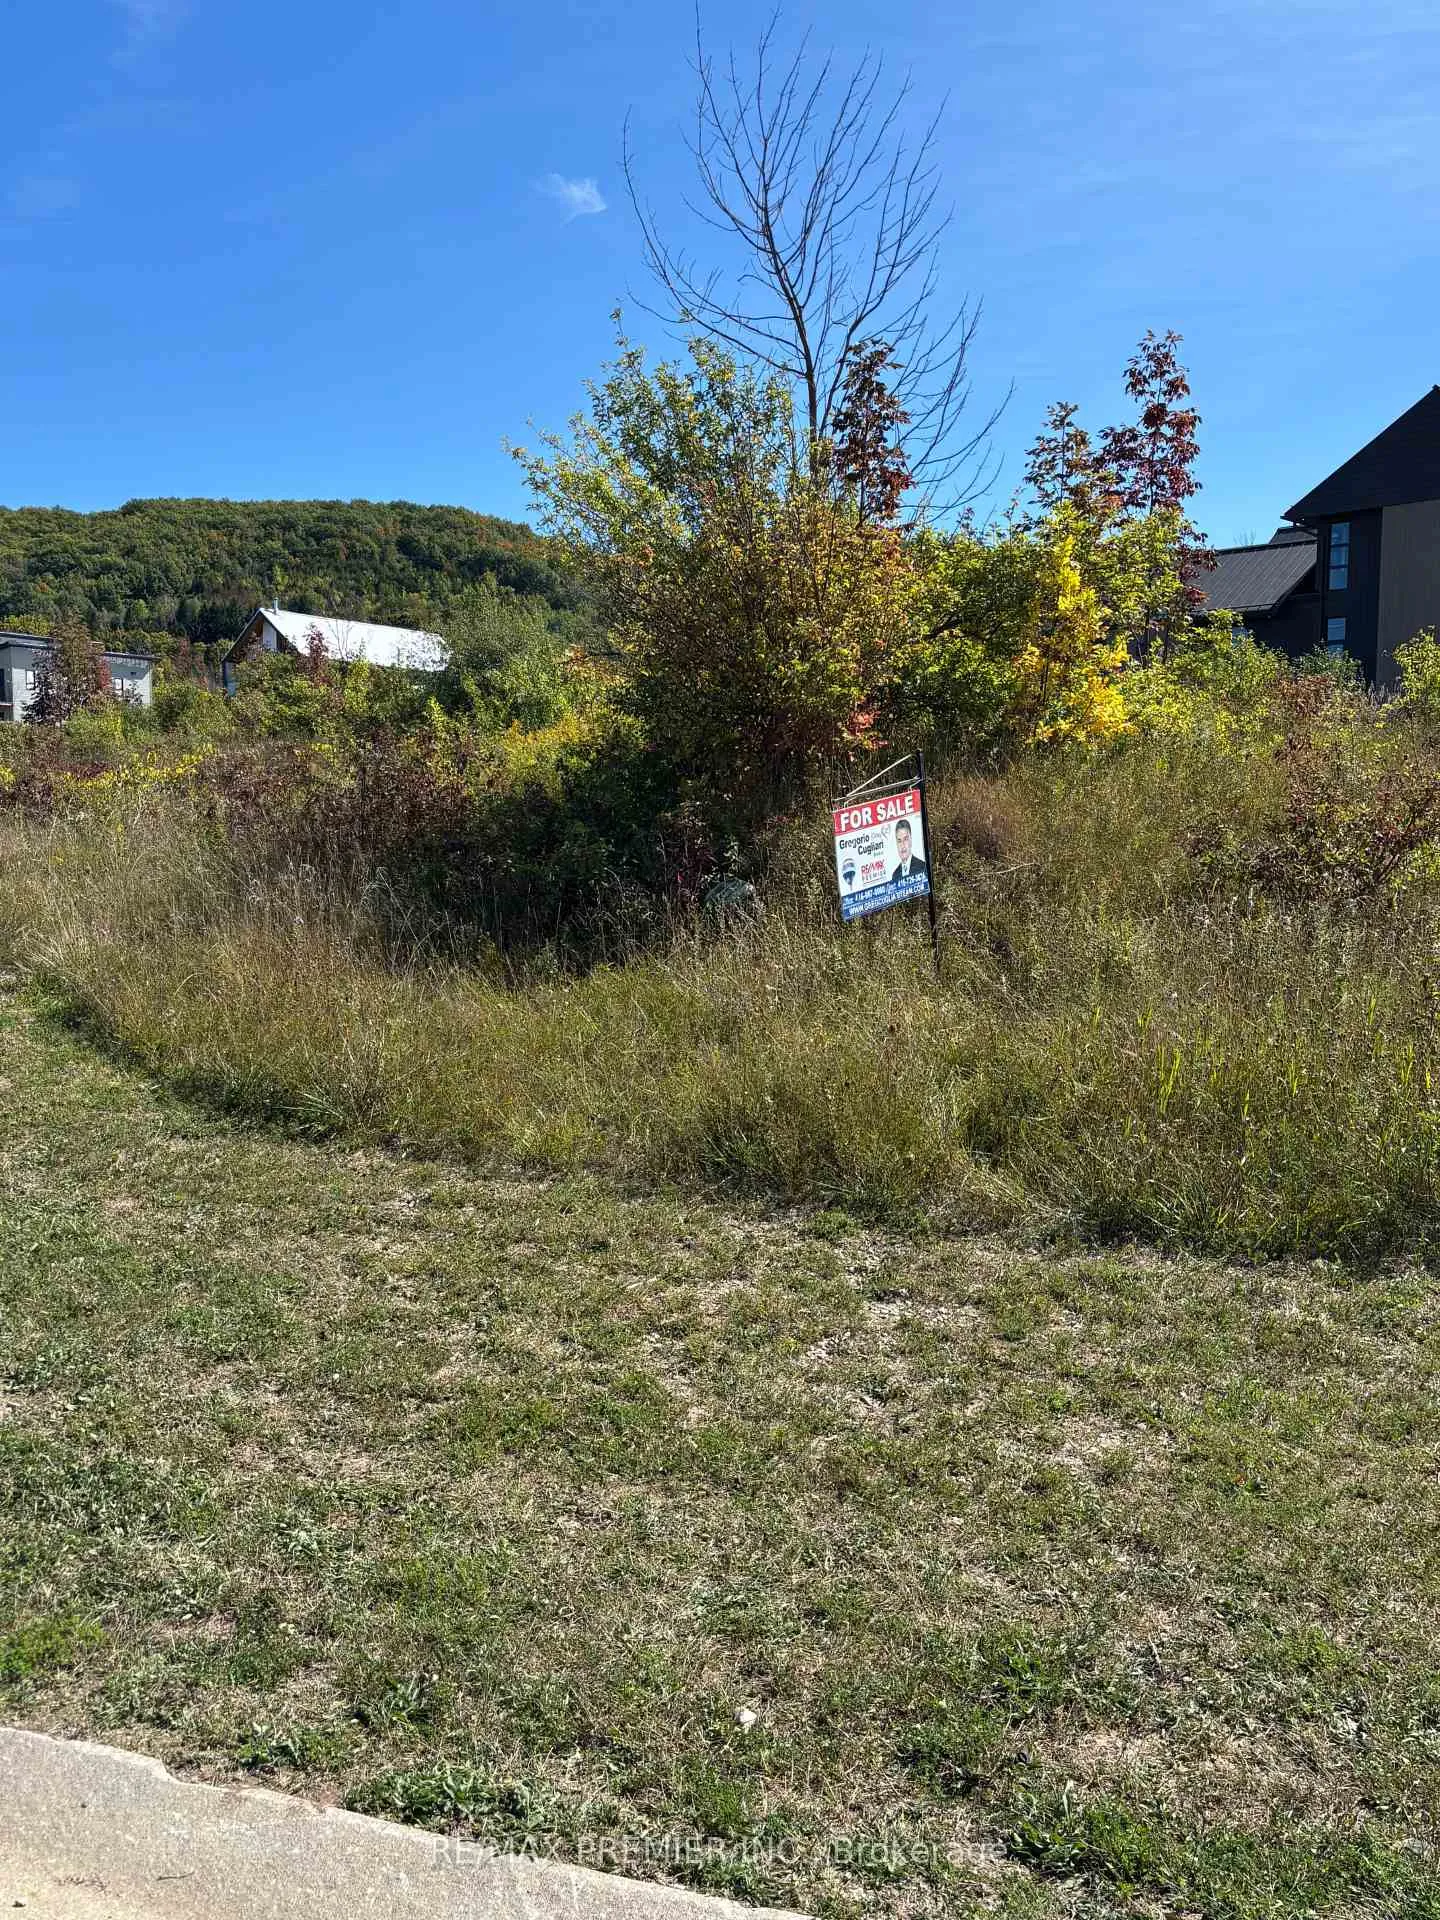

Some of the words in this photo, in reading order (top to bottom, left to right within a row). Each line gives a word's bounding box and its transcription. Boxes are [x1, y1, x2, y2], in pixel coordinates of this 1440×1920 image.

[840, 806, 873, 832] FOR
[876, 795, 915, 822] SALE
[839, 832, 870, 850] Gregorio
